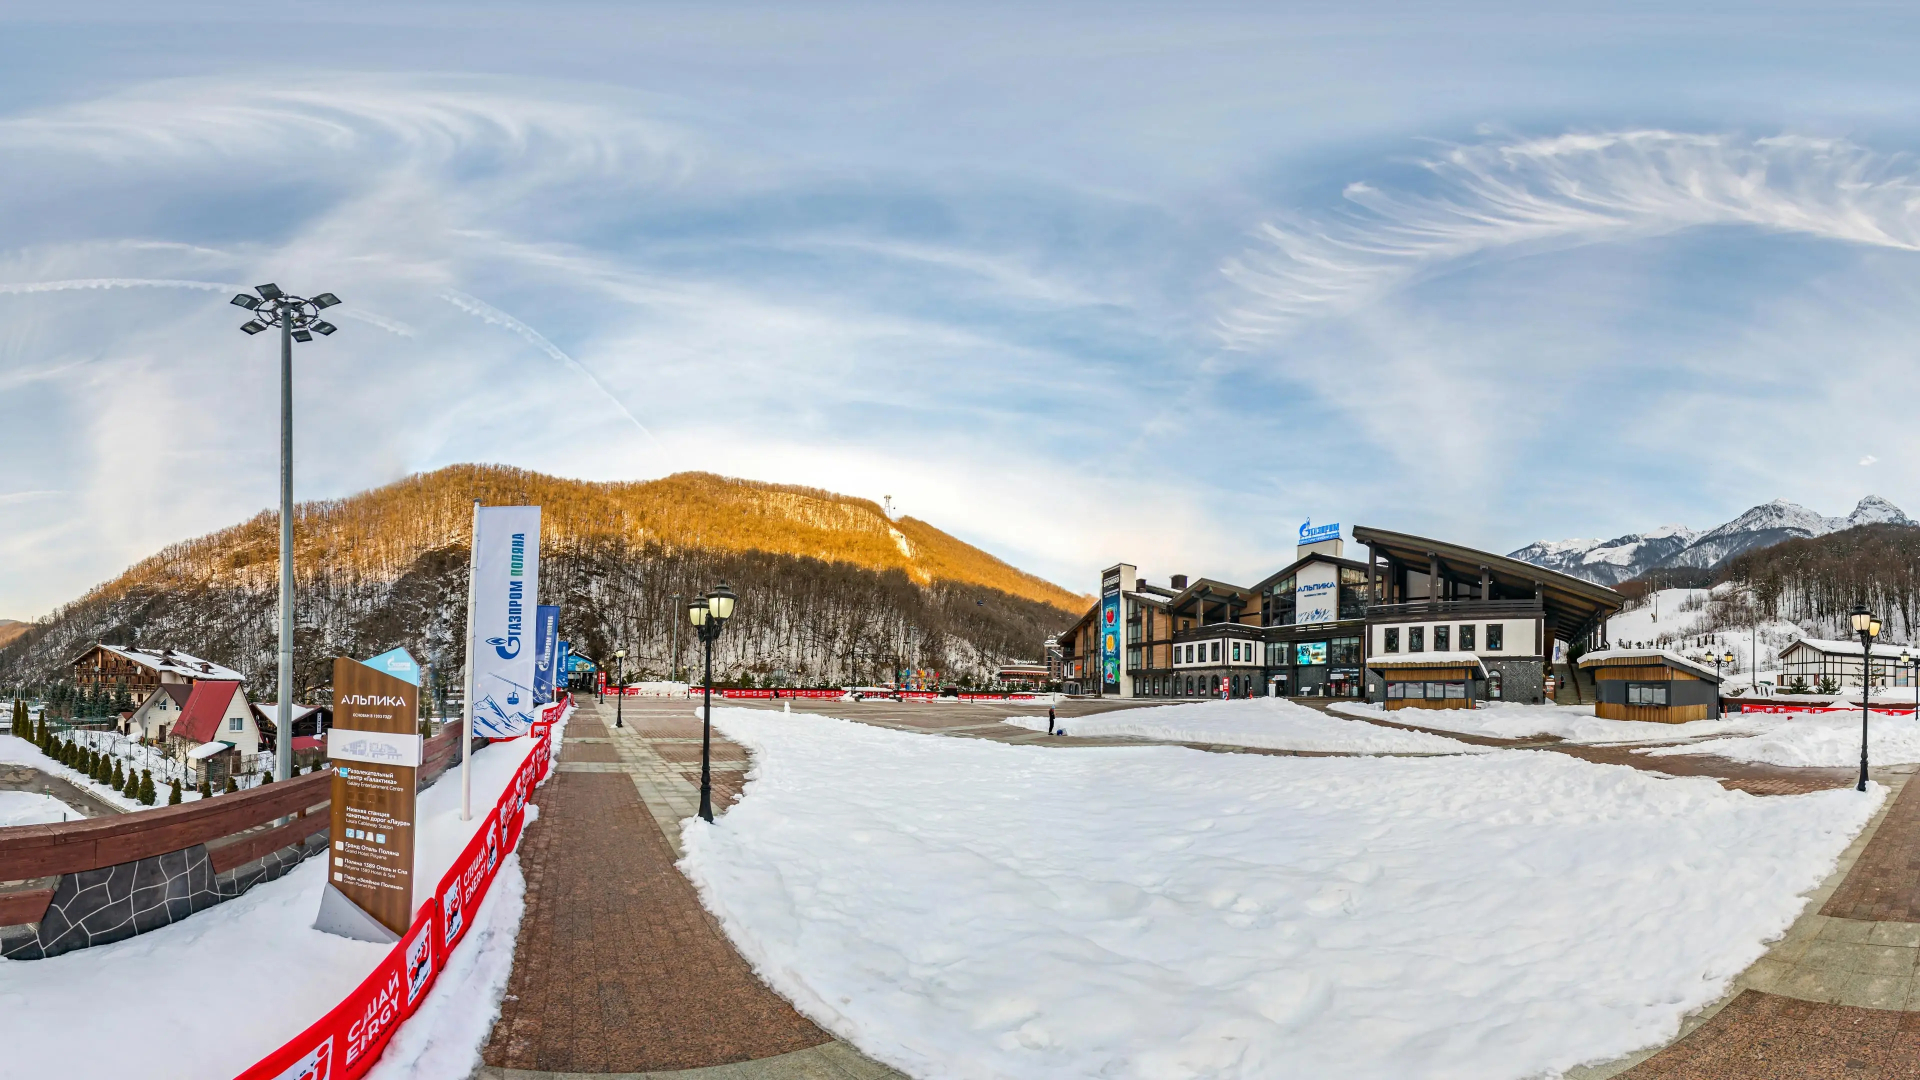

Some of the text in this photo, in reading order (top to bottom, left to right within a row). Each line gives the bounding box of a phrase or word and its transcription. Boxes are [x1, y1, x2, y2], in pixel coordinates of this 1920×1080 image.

[508, 533, 525, 635] ГАЗПРОМ ПОЛЯНА
[1297, 582, 1336, 592] АЛЬПИКА
[341, 694, 406, 707] АЛЬПИКА
[346, 806, 390, 818] Нижняя станция
[345, 841, 400, 857] Гранд Отель Поляна
[465, 859, 487, 904] ENERGY
